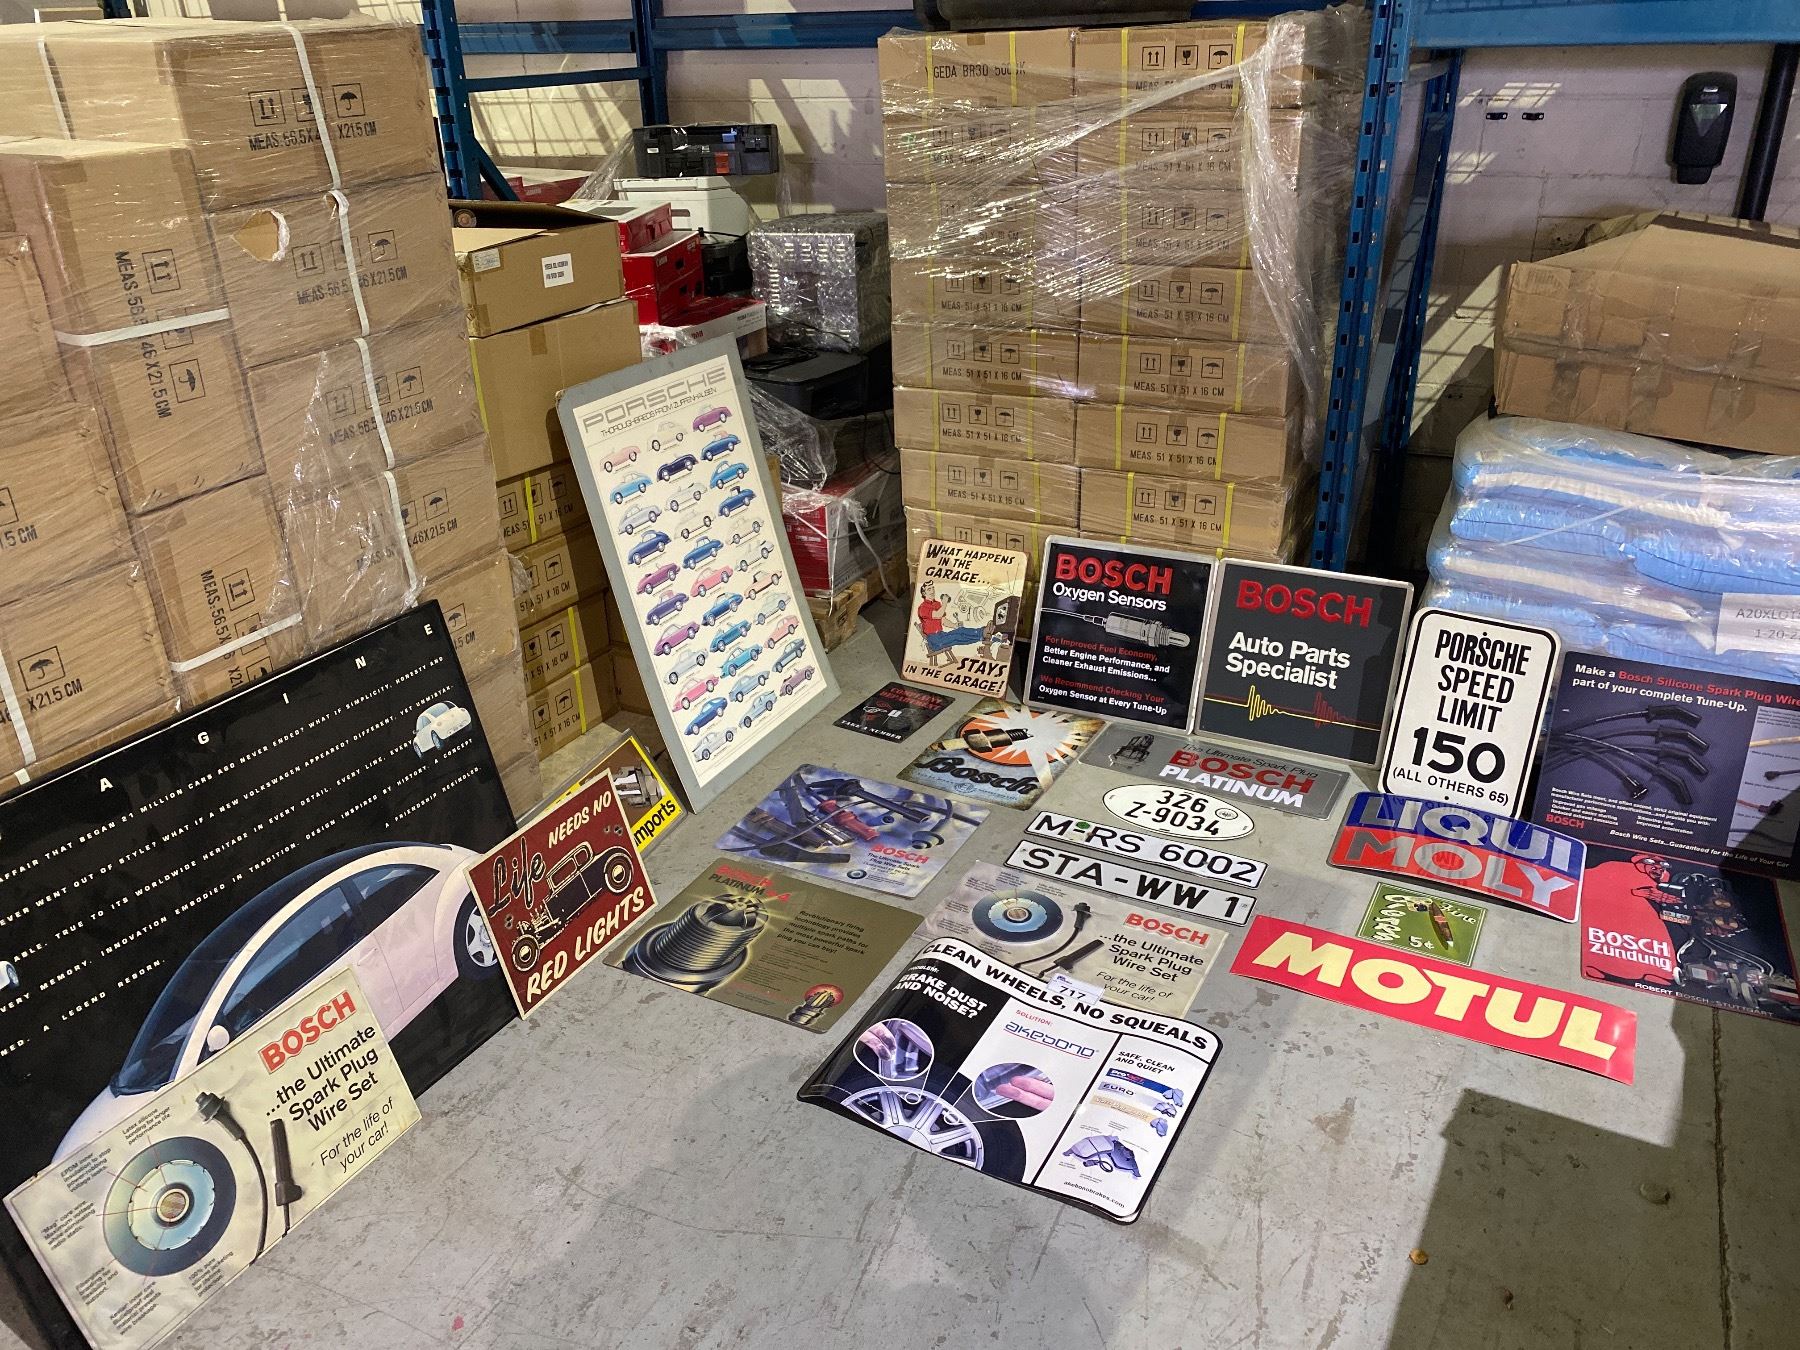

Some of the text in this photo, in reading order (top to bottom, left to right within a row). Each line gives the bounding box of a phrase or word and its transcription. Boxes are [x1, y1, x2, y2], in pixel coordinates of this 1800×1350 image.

[583, 366, 727, 434] PORSCHE
[1159, 515, 1168, 526] 51
[1179, 518, 1189, 528] 51
[1200, 520, 1208, 530] 16
[1210, 522, 1222, 532] CM
[926, 543, 1016, 565] WHAT HAPPENS
[938, 557, 972, 570] IN THE
[1055, 552, 1174, 596] BOSCH
[1052, 582, 1167, 612] Oxygen Sensors
[1236, 579, 1374, 628] BOSCH
[1045, 635, 1059, 645] For
[1060, 637, 1097, 652] Improved
[1099, 644, 1117, 654] Fuel
[1228, 631, 1351, 669] Auto Parts
[1434, 628, 1532, 676] PORSCHE
[1755, 629, 1800, 639] 1-20-2
[905, 664, 918, 674] IN
[920, 667, 943, 680] THE
[944, 673, 1006, 693] GARAGE!
[957, 657, 1008, 678] STAYS
[1042, 655, 1073, 668] Cleaner
[1074, 660, 1106, 674] Exhaust
[1044, 645, 1171, 674] Better Engine Performance, and
[1225, 652, 1338, 690] Specialist
[64, 679, 83, 697] CM
[1038, 684, 1167, 716] Oxygen Sensor at Every Tune-Up
[1055, 676, 1104, 692] Recommend
[1105, 686, 1143, 701] Checking
[1145, 692, 1165, 704] Your
[1437, 664, 1515, 704] SPEED
[1572, 677, 1748, 713] part of your complete Tune-Up.
[1575, 663, 1606, 677] Make
[1608, 670, 1616, 679] a
[1618, 670, 1653, 685] Bosch
[1656, 676, 1704, 692] Silicone
[1706, 683, 1742, 698] Spark
[1744, 689, 1772, 704] Plug
[1436, 695, 1503, 733] LIMIT
[1168, 749, 1316, 794] BOSCH
[1411, 726, 1506, 784] 150
[44, 841, 73, 860] THAT
[79, 821, 116, 844] BEGAN
[139, 788, 183, 814] MILLION
[188, 773, 213, 790] CARS
[217, 762, 236, 776] AGO
[239, 745, 268, 764] NEVER
[308, 715, 331, 729] WHAT
[915, 756, 1041, 795] Bosch
[1158, 764, 1305, 808] PLATINUM
[1392, 766, 1509, 806] (ALL OTHERS 65)
[548, 790, 612, 849] NEEDS NO
[1124, 800, 1220, 836] Z-9034
[1156, 789, 1209, 813] 326
[1359, 796, 1573, 872] LIQUI
[1546, 813, 1585, 829] BOSCH
[871, 844, 929, 864] BOSCH
[1158, 843, 1257, 883] 6002
[1346, 831, 1575, 908] MOLY
[487, 835, 547, 917] Life
[708, 873, 765, 895] PLATINUM
[1225, 896, 1239, 919] 1
[525, 886, 646, 1003] RED LIGHTS
[1123, 912, 1211, 945] BOSCH
[1587, 926, 1670, 958] BOSCH
[1141, 941, 1205, 967] Ultimate
[892, 982, 979, 1019] AND NOISE?
[900, 973, 987, 1012] BRAKE DUST
[922, 943, 1208, 1051] CLEAN WHEELS, NO SQUEALS
[1059, 985, 1086, 1000] 717
[1251, 931, 1617, 1061] MOTUL
[1634, 982, 1673, 996] ROBERT
[1675, 991, 1710, 1004] BOSCH
[259, 988, 359, 1074] BOSCH
[1015, 1009, 1053, 1026] SOLUTION:
[306, 1024, 377, 1086] Ultimate
[1003, 1020, 1096, 1059] akebono
[1115, 1057, 1164, 1075] AND QUIET
[1118, 1051, 1176, 1072] SAFE, CLEAN
[289, 1048, 381, 1122] Spark Plug
[307, 1072, 380, 1135] Wire Set
[319, 1097, 396, 1168] For the life of
[338, 1121, 391, 1175] your car!
[1064, 1178, 1126, 1209] akebonobrakes.com
